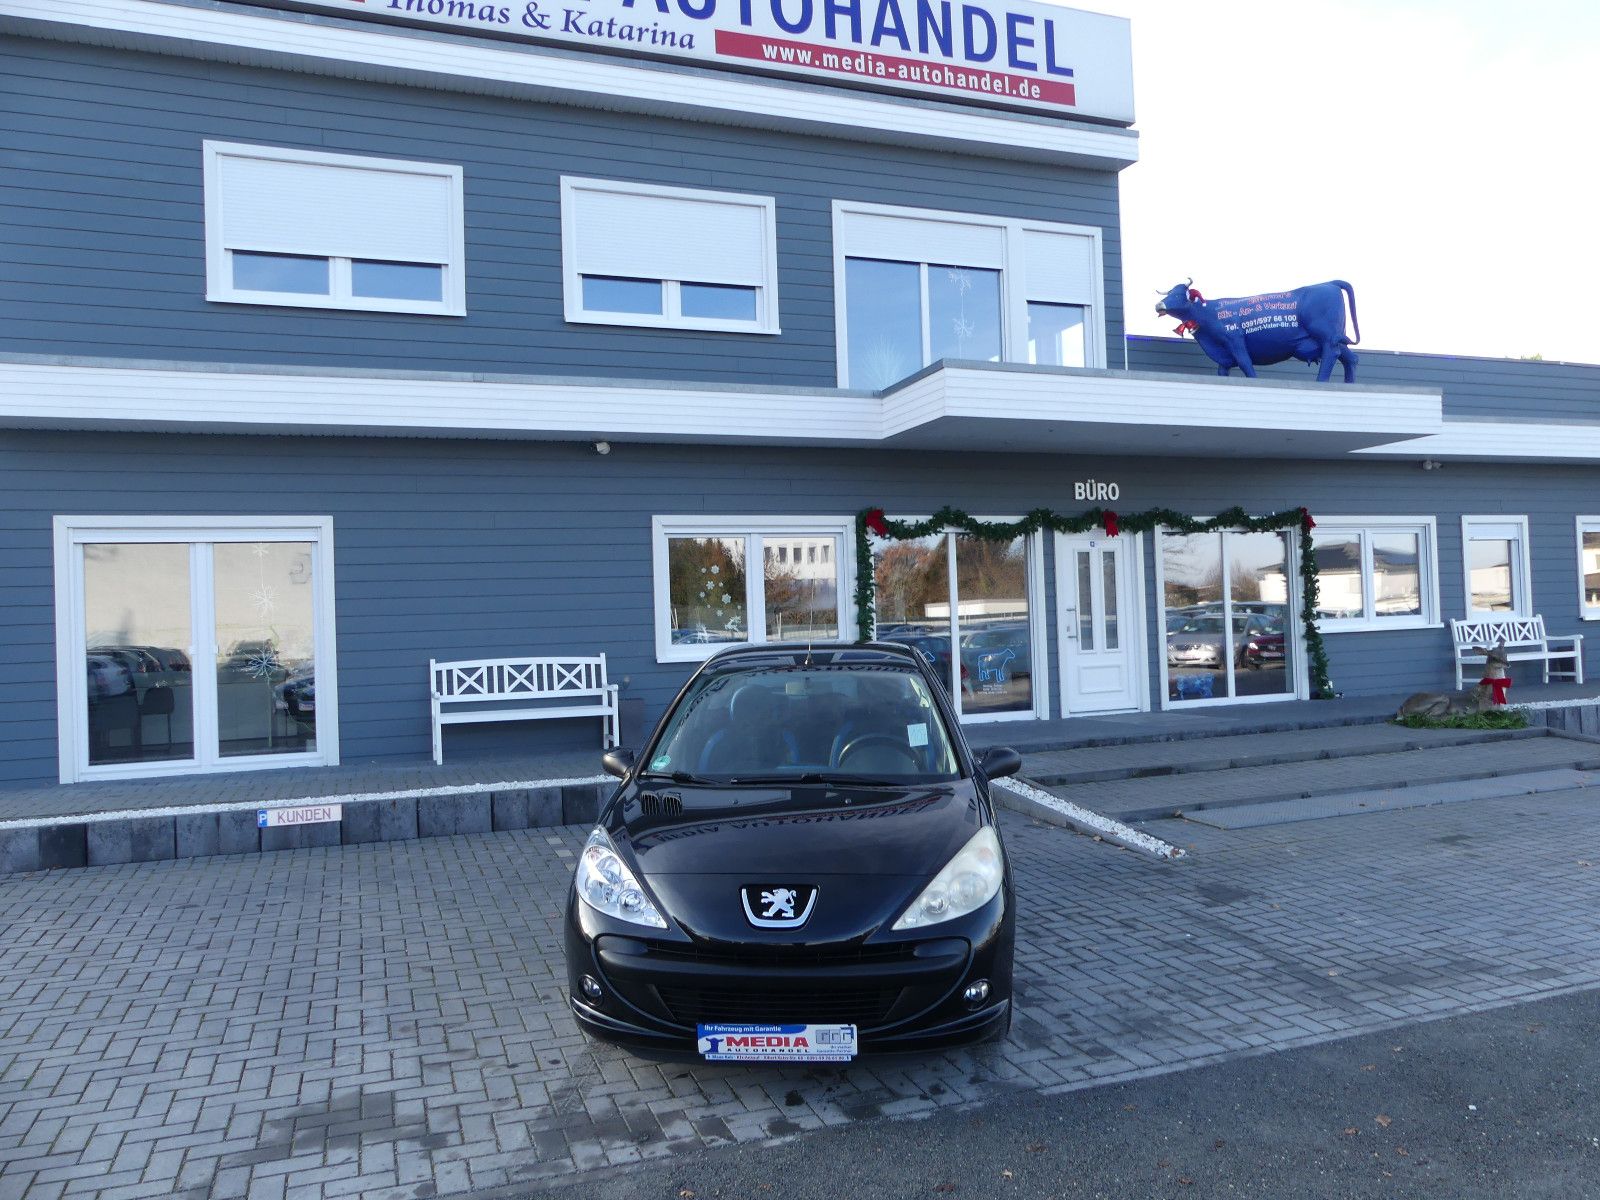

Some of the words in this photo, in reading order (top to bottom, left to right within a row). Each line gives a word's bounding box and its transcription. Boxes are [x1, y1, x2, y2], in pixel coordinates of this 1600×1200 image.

[521, 1, 552, 31] &
[560, 8, 697, 50] Katarina
[621, 0, 1075, 78] OHANDEL
[762, 44, 1041, 99] www.media-autohandel.de
[1225, 324, 1239, 332] Tel.
[1284, 314, 1297, 322] 100
[1074, 479, 1120, 501] BÜRO
[259, 813, 267, 823] P
[277, 807, 332, 824] KUNDEN
[714, 1025, 743, 1033] Fahrzeug
[726, 1036, 809, 1048] MEDIA
